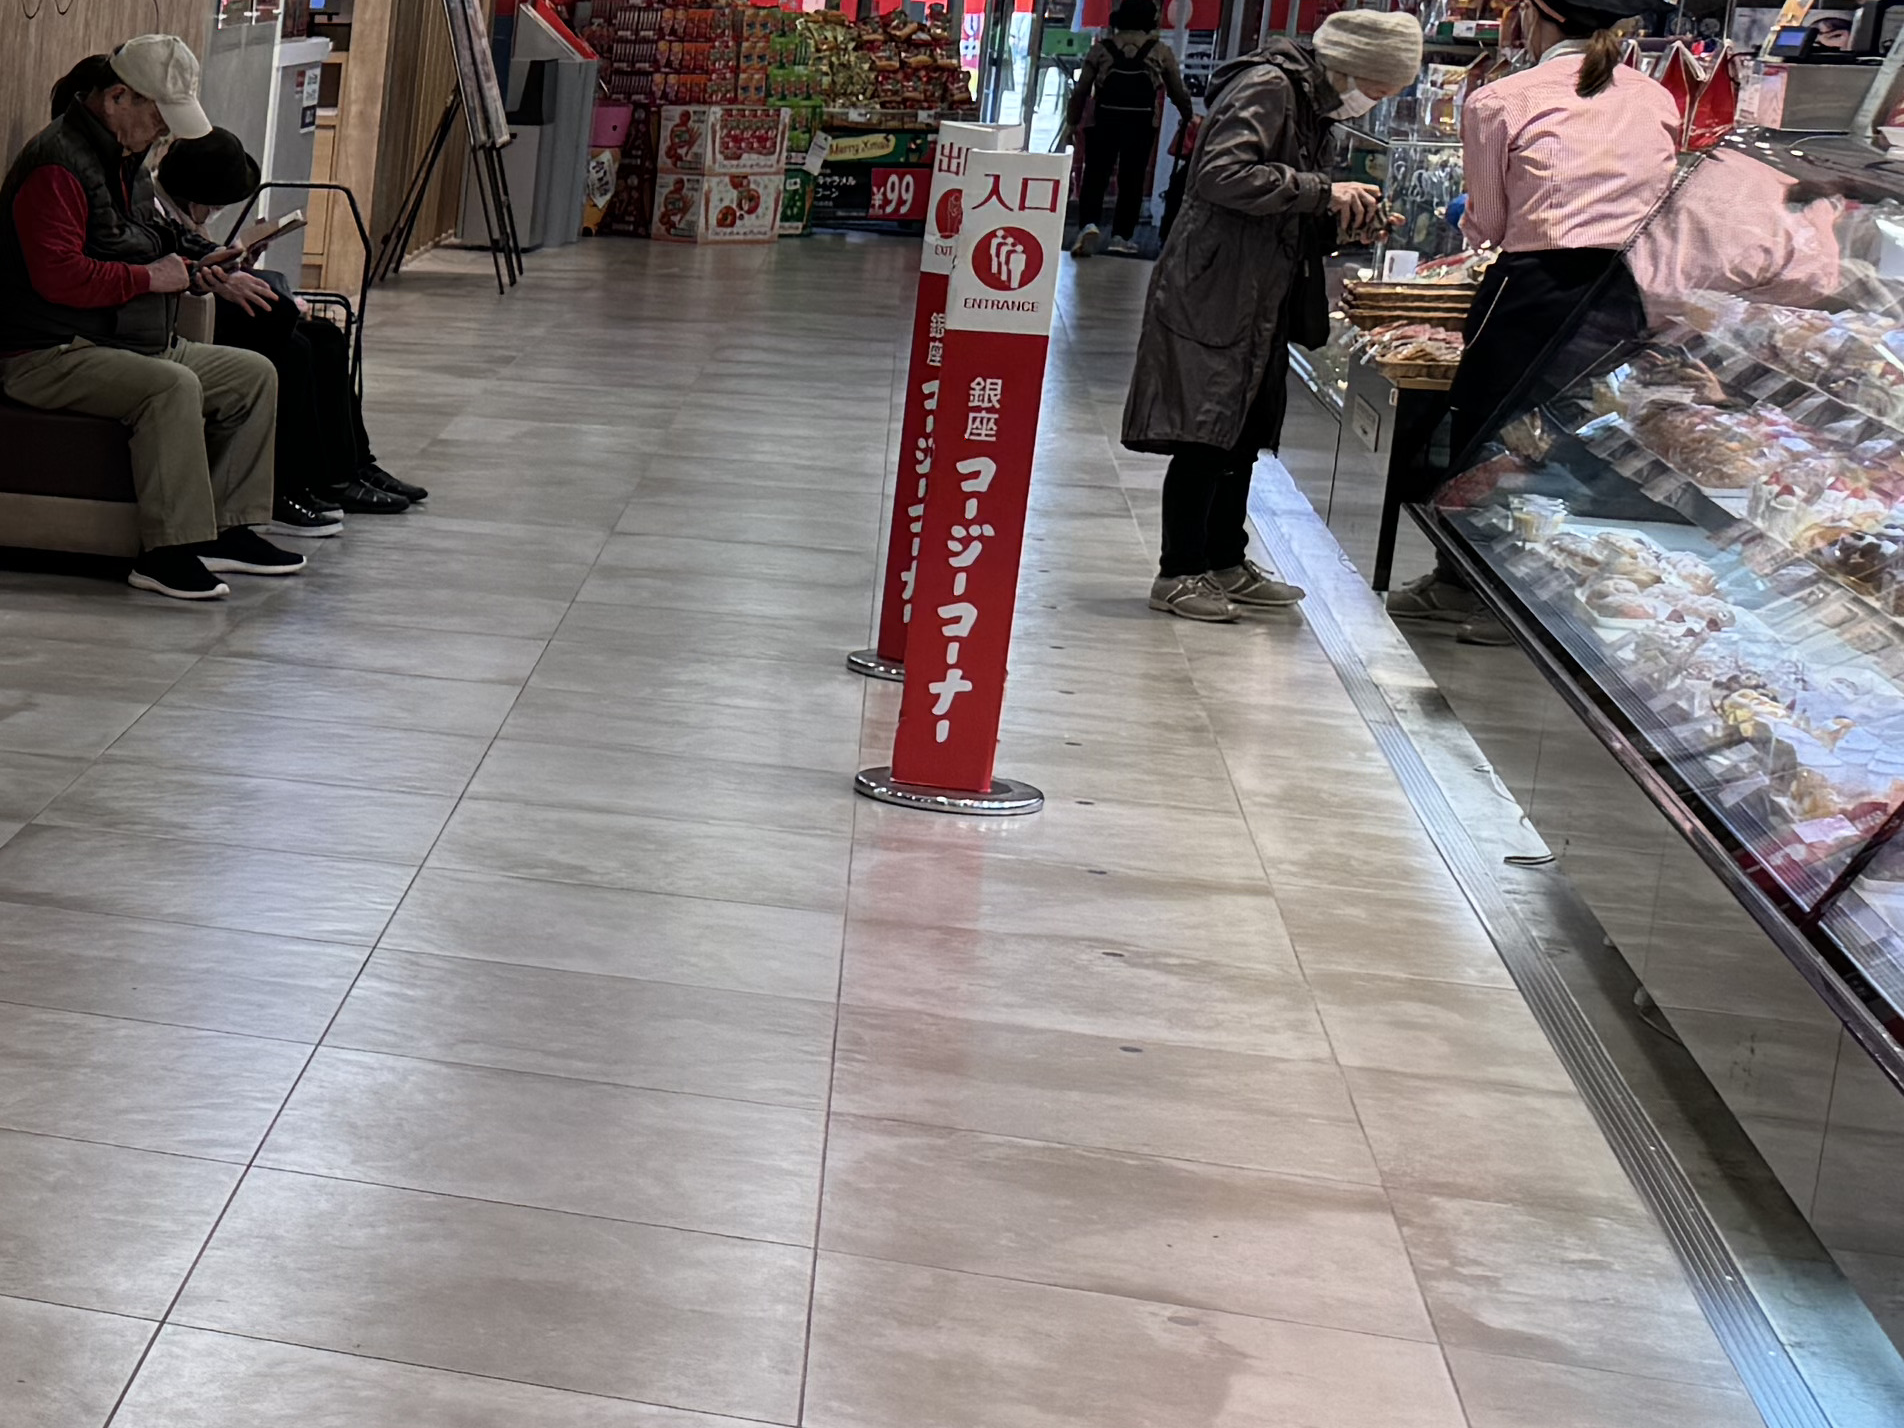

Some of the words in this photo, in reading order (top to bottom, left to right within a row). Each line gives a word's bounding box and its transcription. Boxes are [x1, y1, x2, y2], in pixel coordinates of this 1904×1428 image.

[829, 140, 859, 156] Merry
[938, 143, 969, 176] 出
[873, 173, 915, 214] ¥99
[970, 172, 1061, 215] 入口
[962, 296, 1041, 314] ENTRANCE
[964, 376, 1002, 443] 銀座
[927, 456, 997, 744] コージーコーナー
